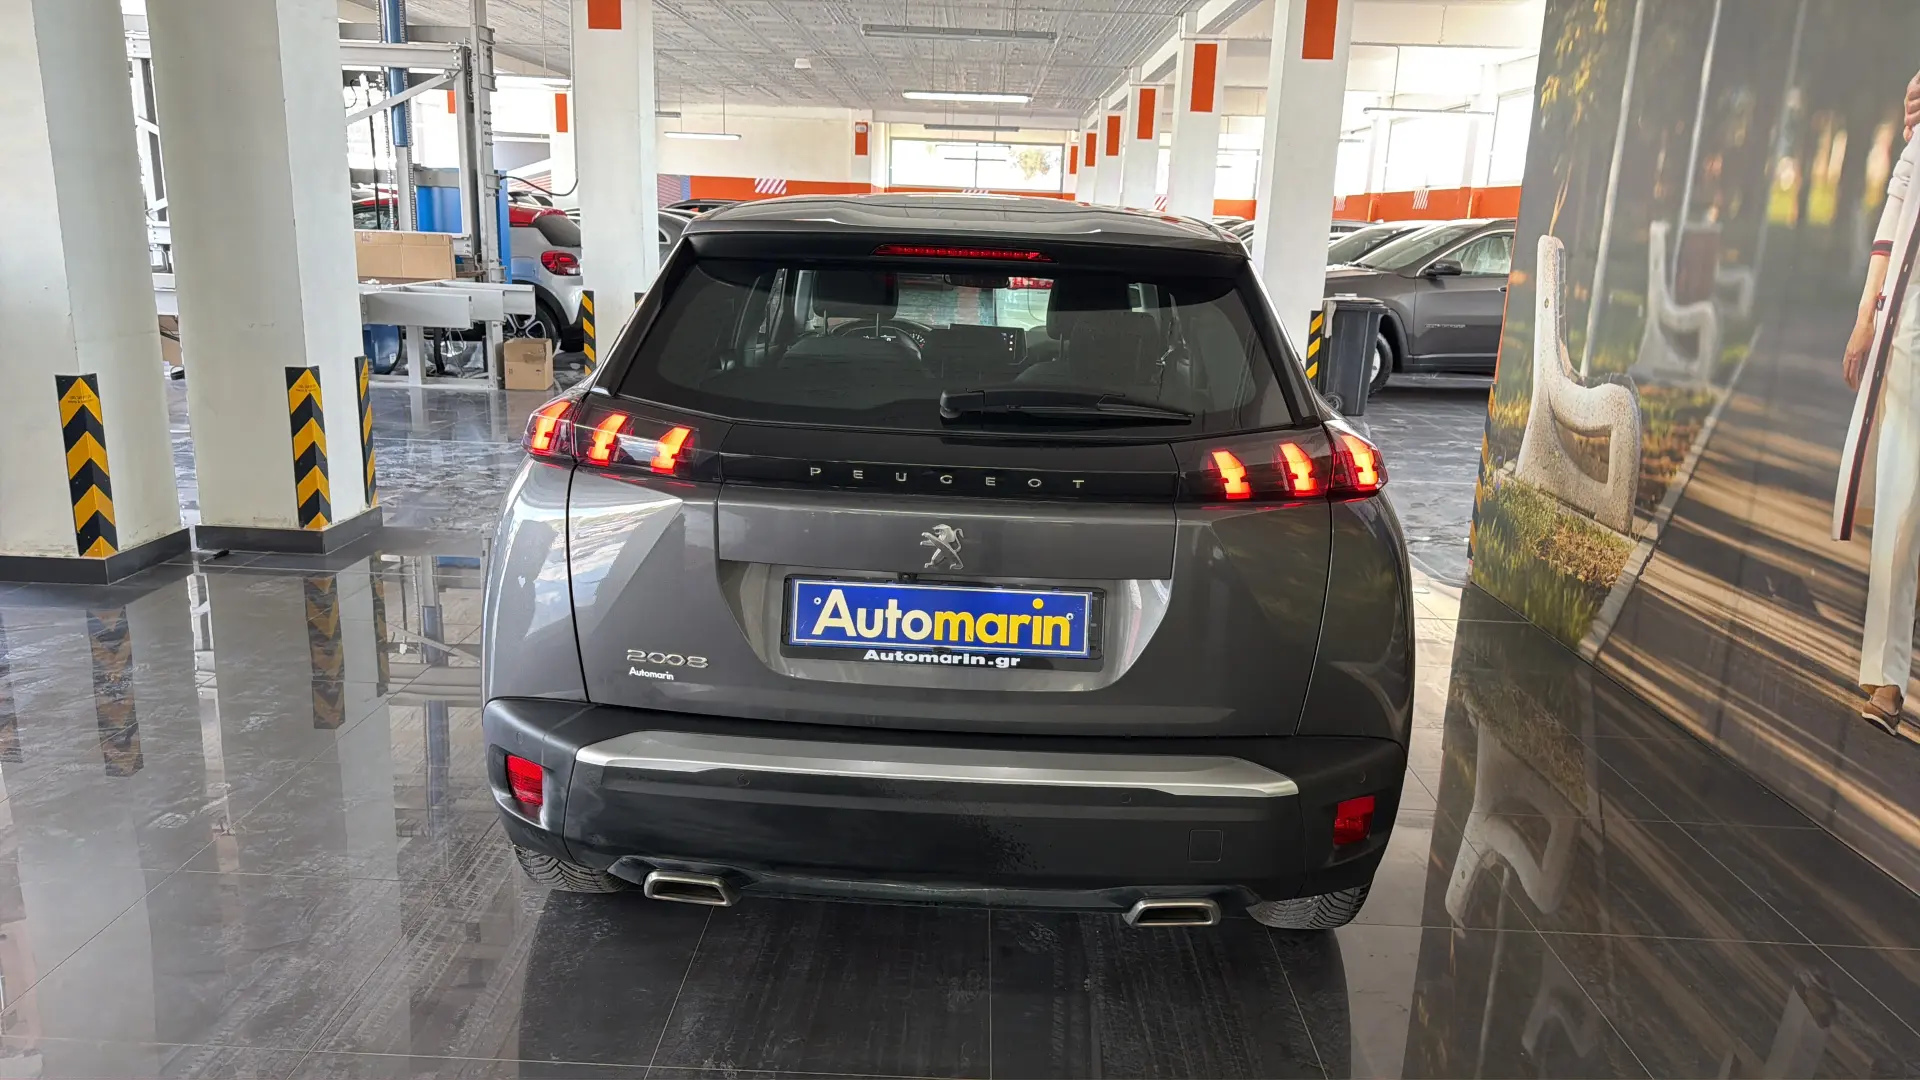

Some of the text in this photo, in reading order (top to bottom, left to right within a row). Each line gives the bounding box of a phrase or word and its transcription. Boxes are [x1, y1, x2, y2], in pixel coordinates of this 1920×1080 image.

[809, 466, 1085, 489] PEUGEOT
[811, 588, 1071, 646] Automarin
[626, 649, 708, 668] 2008
[863, 649, 1021, 669] Automarin.gr
[628, 666, 674, 681] Automarin
